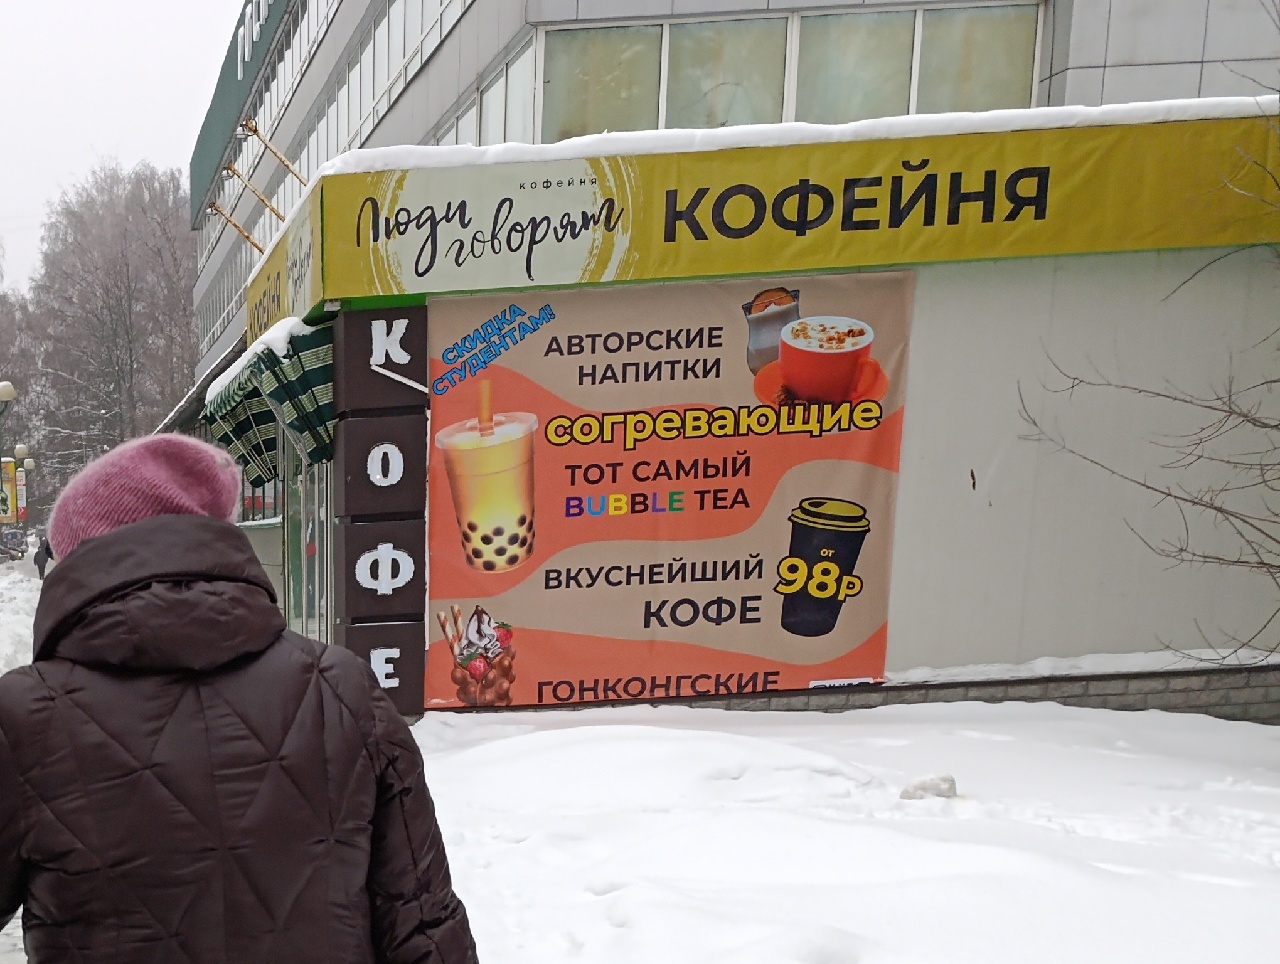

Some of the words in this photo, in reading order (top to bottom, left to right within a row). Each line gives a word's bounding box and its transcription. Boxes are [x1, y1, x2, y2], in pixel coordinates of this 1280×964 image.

[519, 176, 598, 190] кофейня
[663, 158, 1051, 243] КОФЕЙНЯ
[356, 196, 472, 277] Люди
[445, 197, 624, 281] говорят
[432, 304, 555, 395] СТУДЕНТАМ!
[442, 304, 526, 364] СКИДКА
[543, 326, 724, 357] АВТОРСКИЕ
[578, 357, 722, 386] НАПИТКИ
[545, 399, 883, 450] согревающие
[565, 463, 623, 486] ТОТ
[631, 450, 751, 482] САМЫЙ
[355, 318, 415, 688] КОФЕ
[565, 491, 685, 517] BUBBLE
[694, 488, 750, 511] TEA
[544, 553, 764, 590] ВКУСНЕЙШИЙ
[643, 595, 762, 629] КОФЕ
[537, 671, 780, 704] ГОНКОНГСКИЕ
